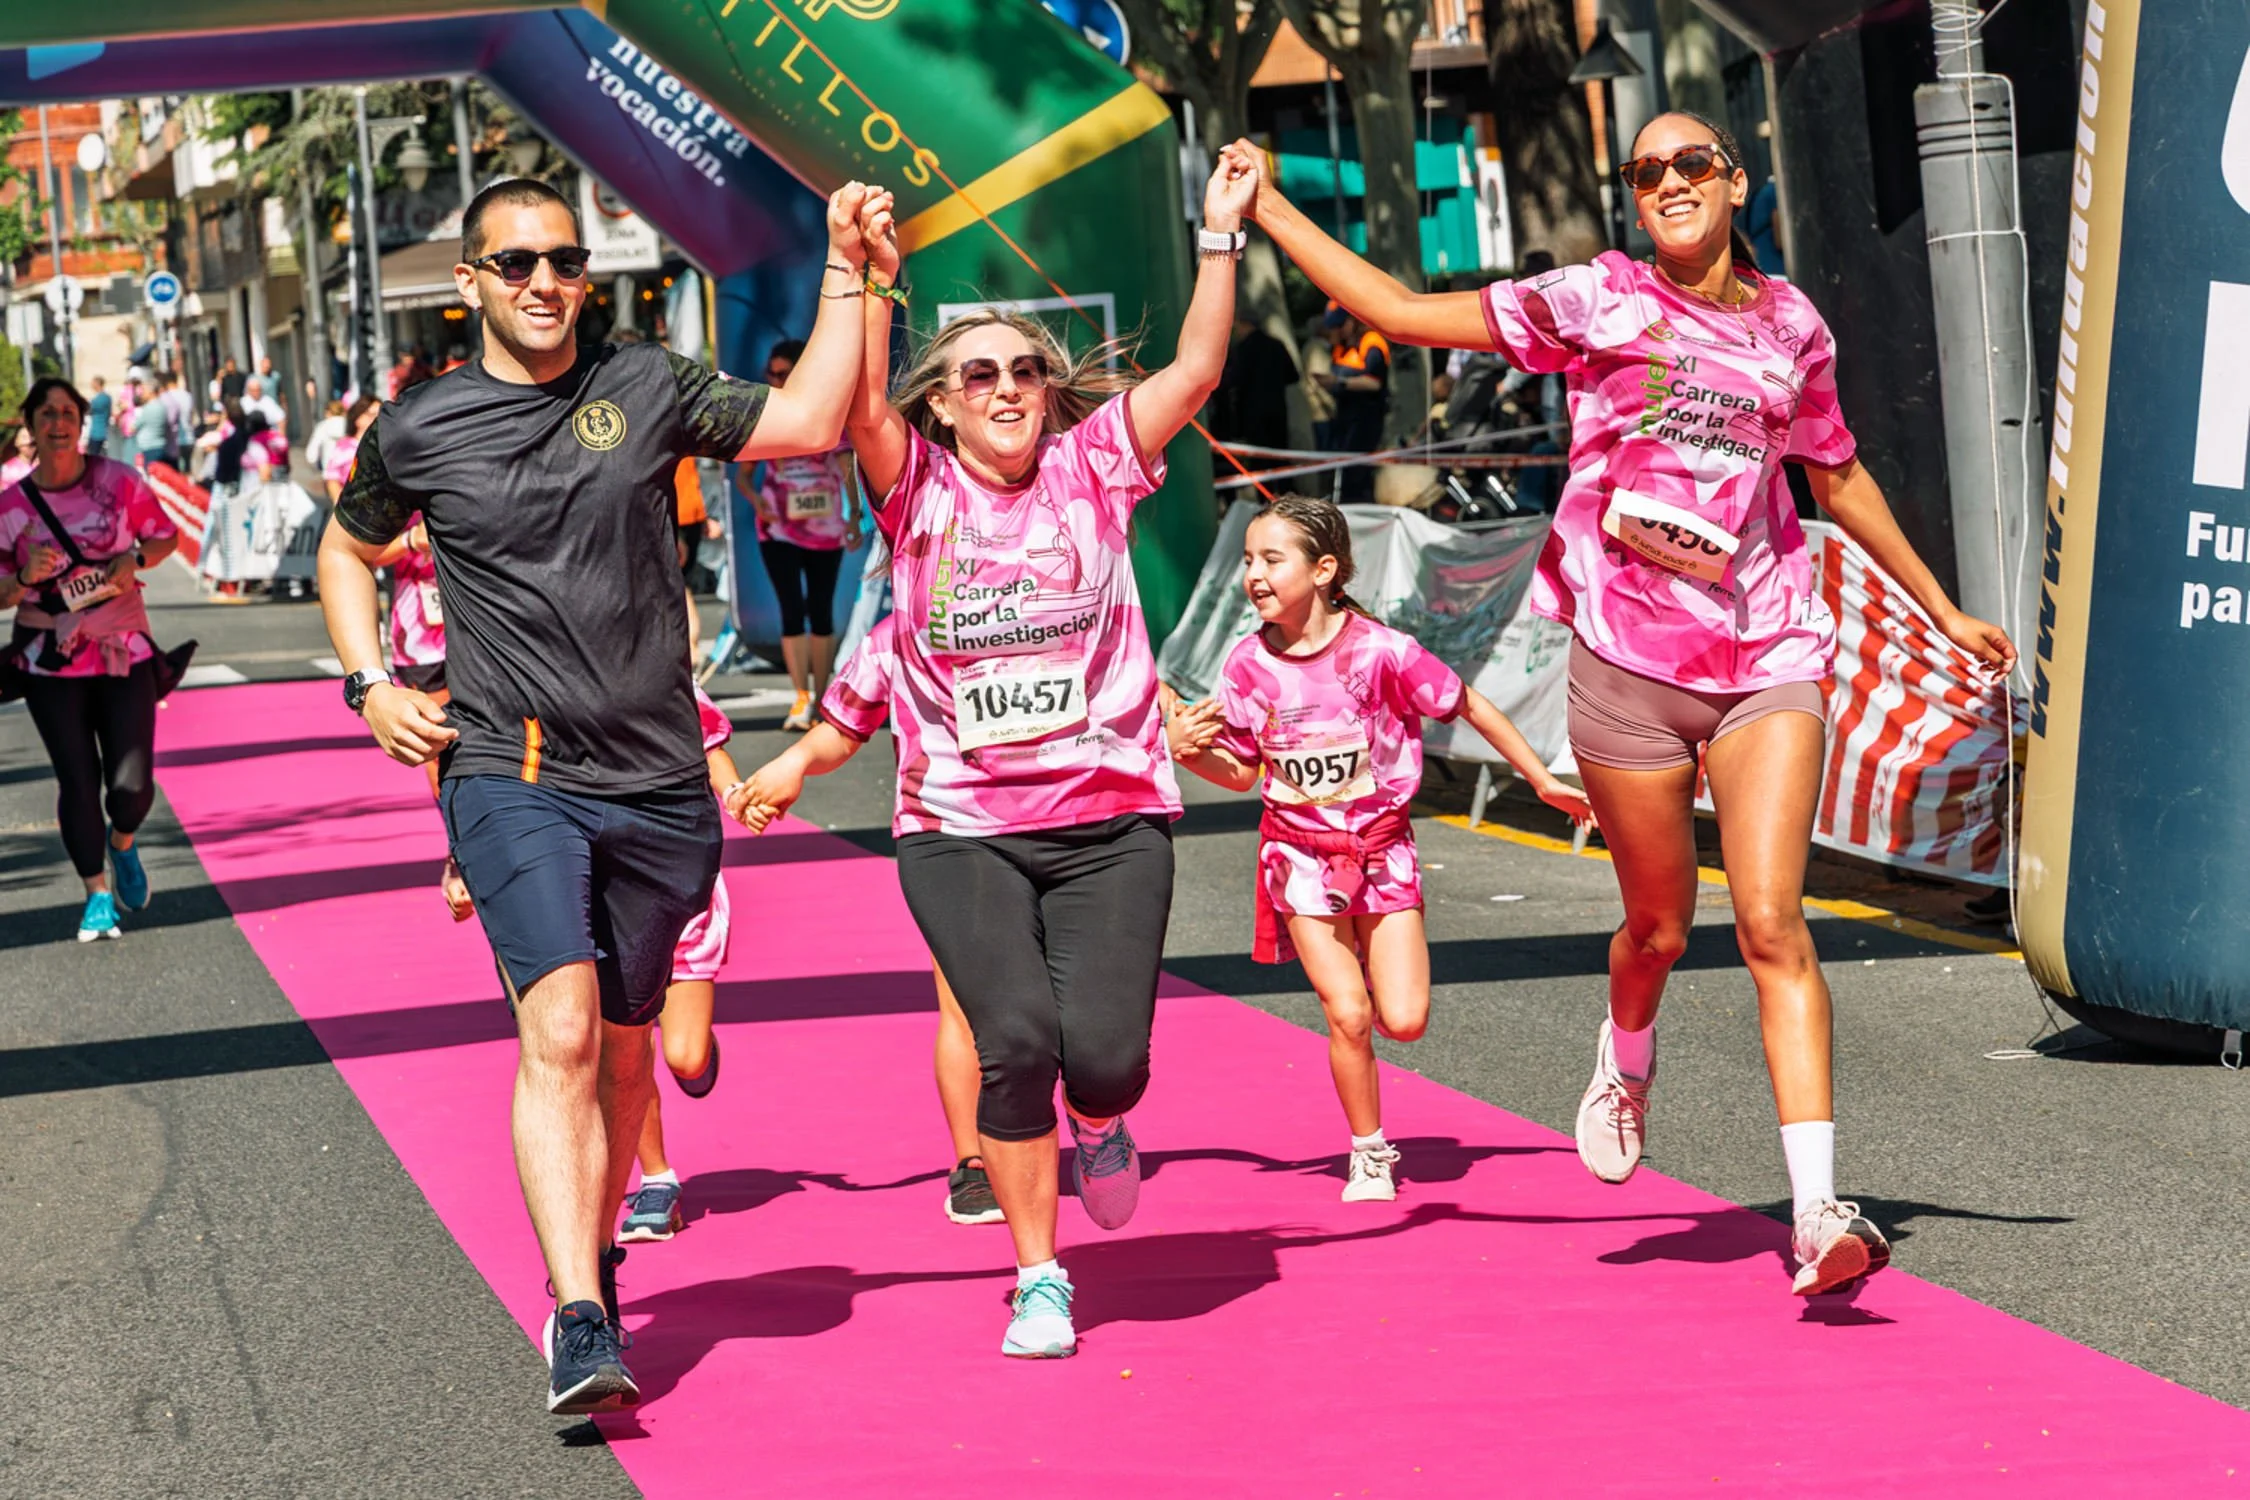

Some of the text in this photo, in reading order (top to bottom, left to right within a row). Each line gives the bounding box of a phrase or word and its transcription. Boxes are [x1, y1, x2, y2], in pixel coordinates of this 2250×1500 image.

[608, 34, 752, 159] nuestra
[586, 56, 726, 188] vocación.
[1673, 354, 1697, 374] XI
[1670, 379, 1757, 413] Carrera
[1666, 407, 1725, 429] por la
[2186, 510, 2250, 564] Fu
[955, 558, 976, 576] XI
[928, 556, 954, 650] mujer
[953, 577, 1035, 601] Carrera
[2180, 581, 2250, 629] pa
[952, 604, 1018, 632] por la
[953, 611, 1099, 651] Investigación
[964, 677, 1073, 722] 10457
